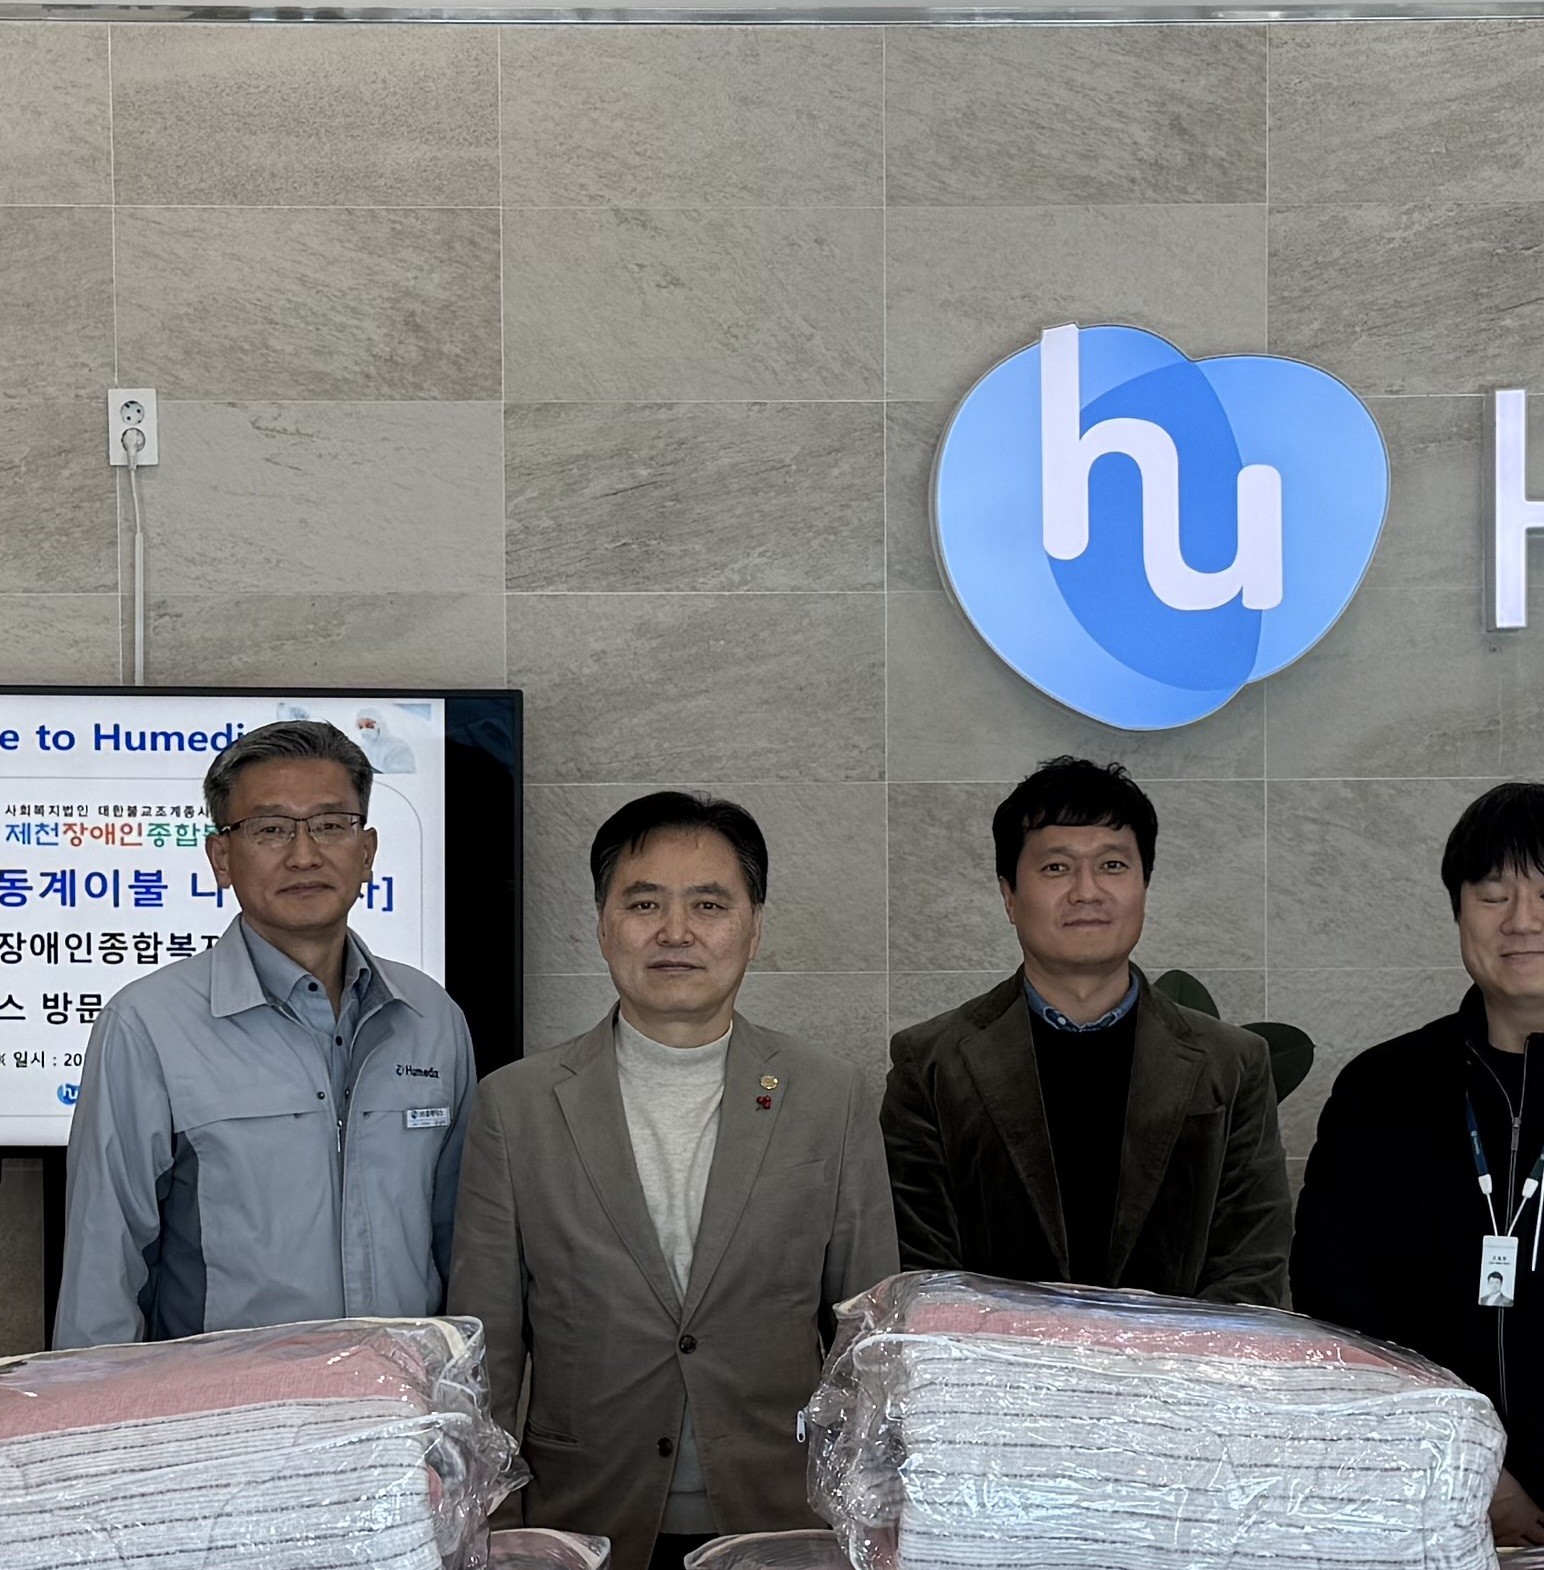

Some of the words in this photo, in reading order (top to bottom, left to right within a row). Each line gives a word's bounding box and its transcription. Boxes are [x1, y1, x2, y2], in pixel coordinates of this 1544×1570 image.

[36, 725, 75, 750] to
[6, 805, 88, 817] 사회복지법인
[98, 805, 210, 819] 대한불교조계종사
[5, 822, 218, 847] 제천장애인종합
[13, 1051, 45, 1068] 일시
